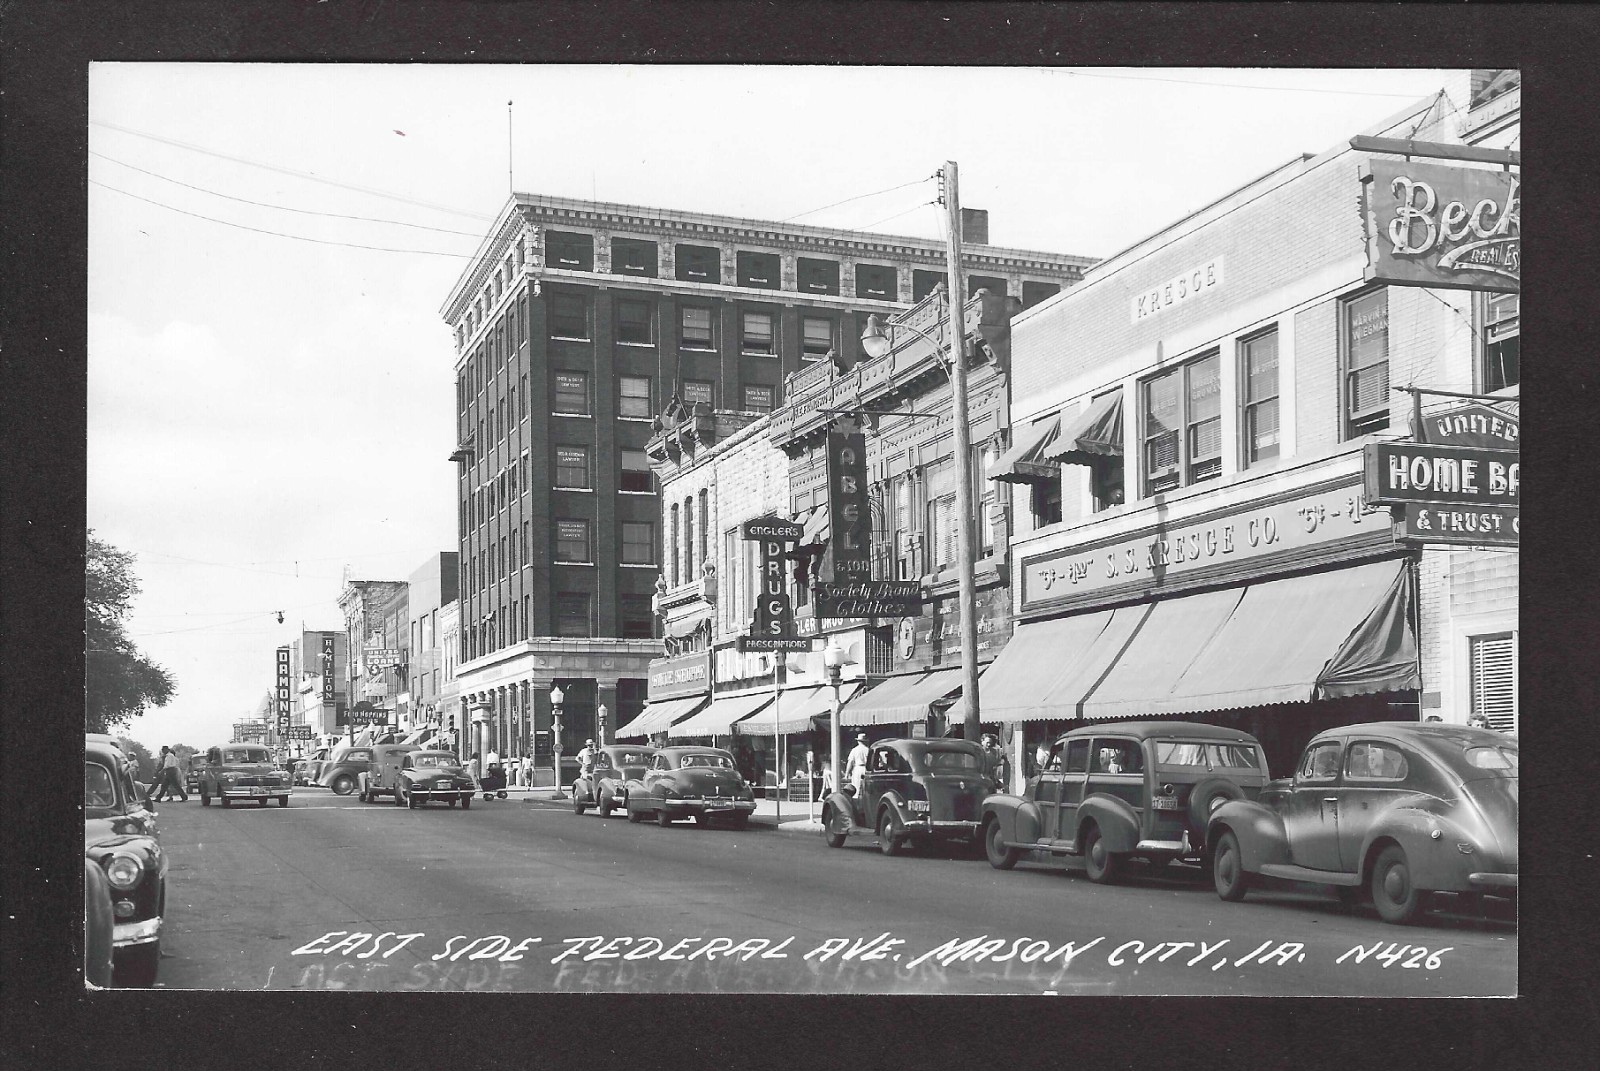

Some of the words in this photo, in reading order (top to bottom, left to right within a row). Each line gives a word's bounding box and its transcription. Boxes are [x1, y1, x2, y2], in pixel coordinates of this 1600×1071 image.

[1137, 262, 1216, 319] KRESGE
[1437, 414, 1519, 442] UNITED
[1389, 454, 1480, 494] HOME
[840, 447, 859, 550] ABEL
[749, 526, 799, 537] ENGLER'S
[1416, 509, 1432, 530] &
[1437, 511, 1502, 533] TRUST
[1146, 525, 1234, 570] KRESGE
[1249, 515, 1280, 547] CO.
[768, 541, 783, 635] DRUGS
[819, 583, 871, 600] Society
[874, 582, 920, 599] Brand
[837, 600, 906, 617] Clothes
[795, 617, 816, 634] LER
[746, 640, 807, 649] PRESCRIPTIONS
[279, 652, 289, 727] DAMON'S
